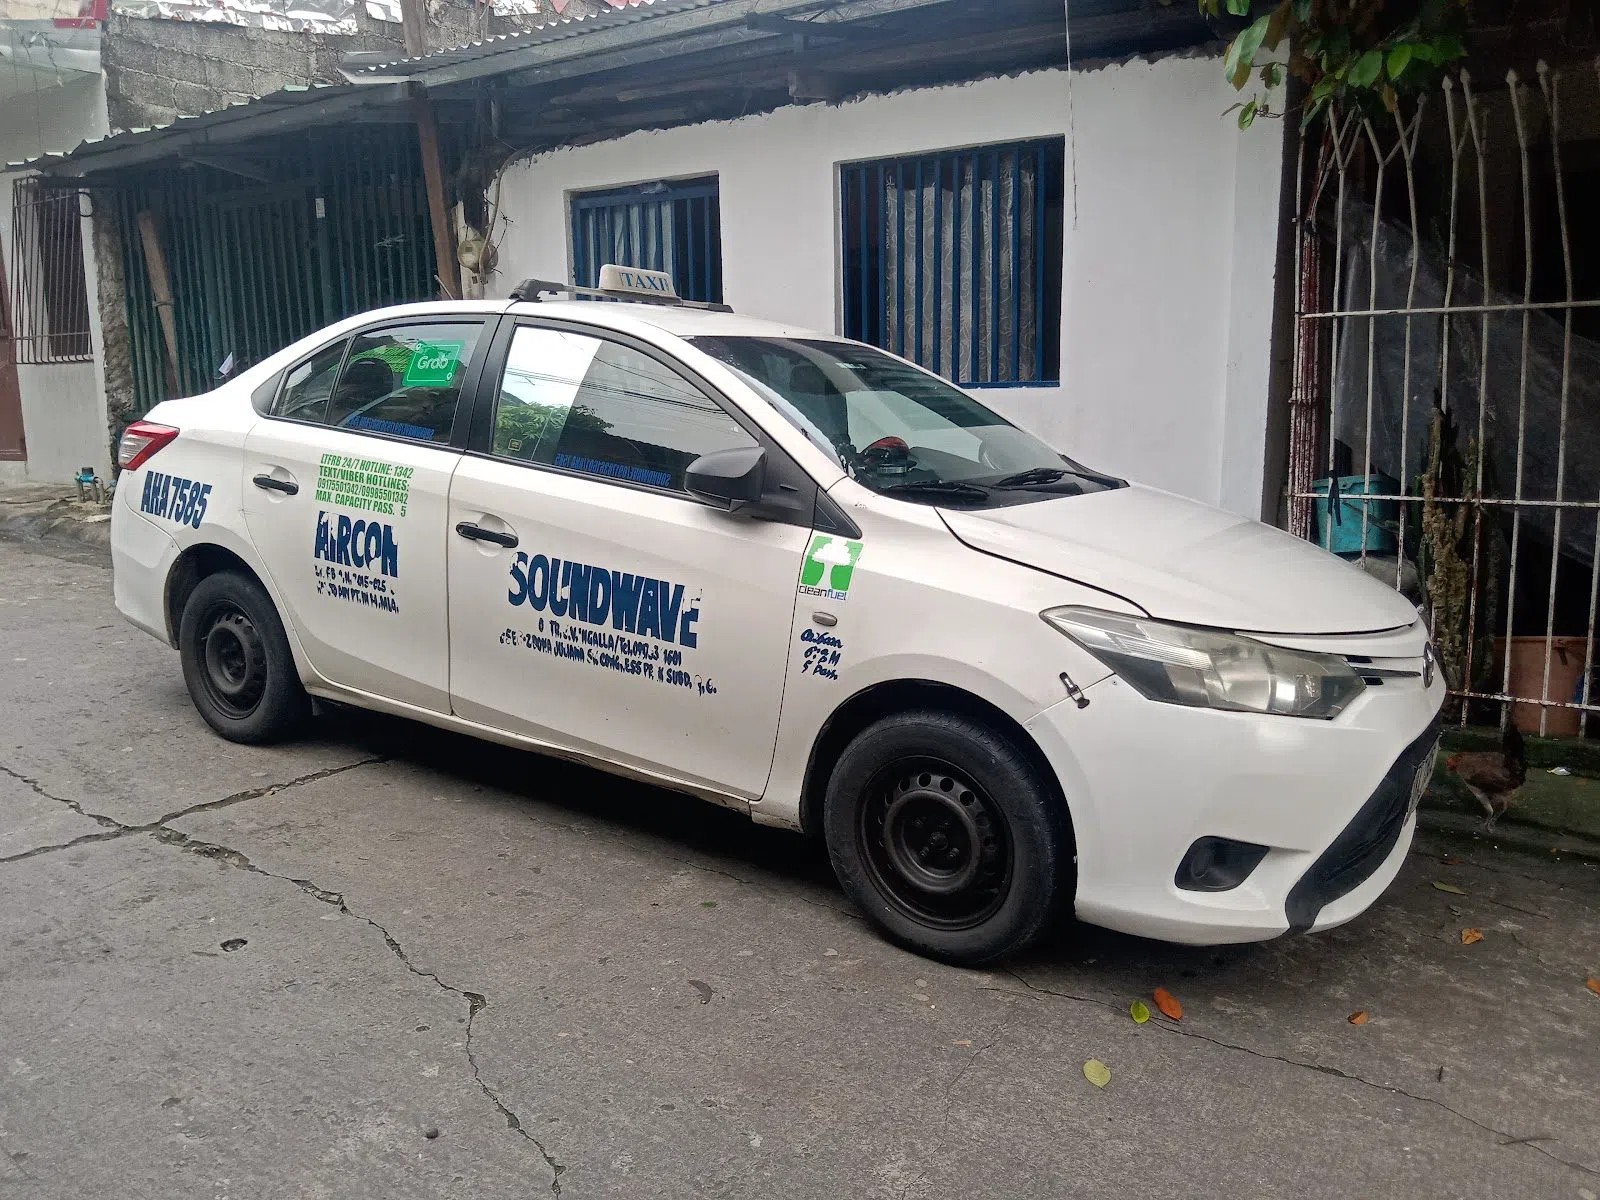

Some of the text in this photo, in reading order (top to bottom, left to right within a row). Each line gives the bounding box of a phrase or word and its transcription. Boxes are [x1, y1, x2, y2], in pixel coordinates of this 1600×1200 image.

[620, 272, 667, 291] TAXI
[417, 351, 449, 369] Grab
[319, 465, 410, 492] TEXT/VIBER HOTLINES:
[342, 456, 360, 469] 24/7
[360, 460, 393, 475] HOTLINE:
[394, 465, 414, 479] 1342
[315, 489, 408, 518] MAX. CAPACITY PASS. 5
[314, 510, 399, 578] AIRCON
[508, 551, 701, 650] SOUNDWAVE
[799, 585, 847, 601] cleanfuel
